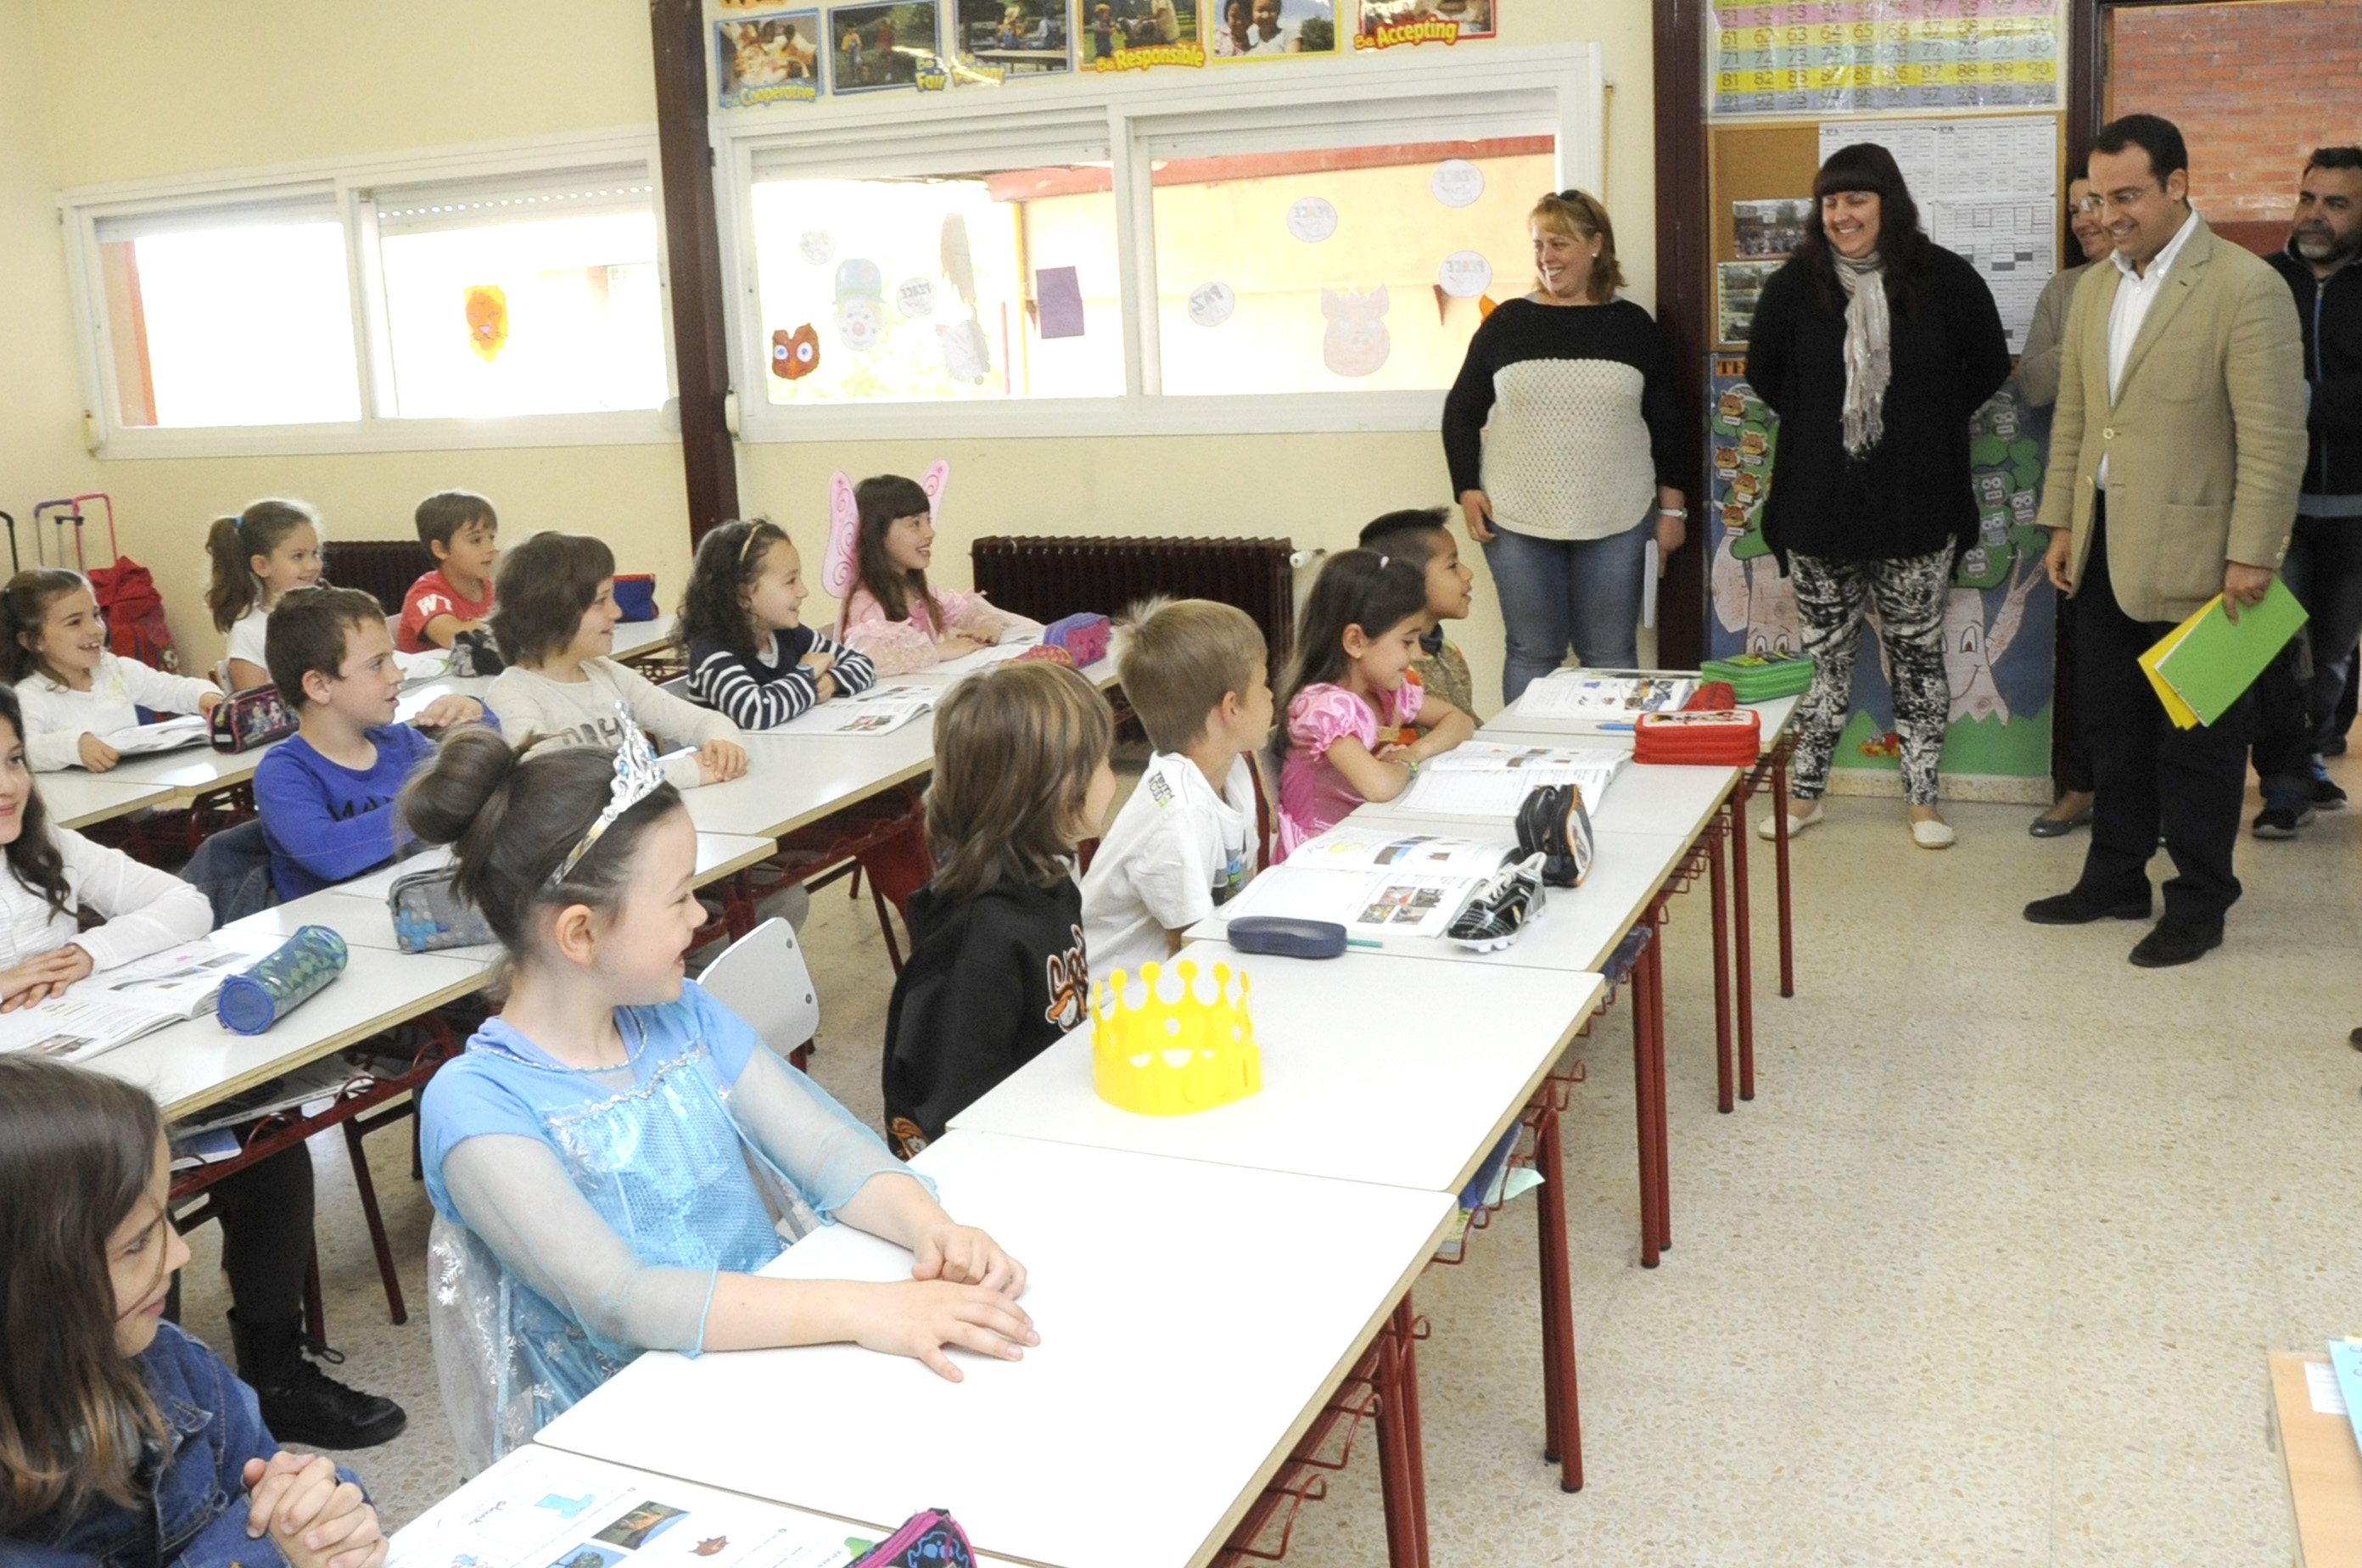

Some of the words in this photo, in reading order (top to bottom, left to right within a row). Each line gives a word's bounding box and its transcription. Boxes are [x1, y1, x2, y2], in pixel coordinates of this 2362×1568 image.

[1722, 9, 1738, 22] 51
[1755, 6, 1772, 20] 52
[1788, 4, 1807, 19] 53
[1354, 35, 1374, 49] Be
[1376, 17, 1458, 48] Accepting
[1721, 31, 1738, 45] 61
[1754, 28, 1774, 43] 62
[1787, 26, 1807, 41] 63
[1821, 25, 1841, 39] 64
[1854, 23, 1873, 38] 65
[1887, 23, 1910, 36] 66
[1922, 21, 1941, 36] 67
[1957, 20, 1979, 34] 68
[1993, 18, 2013, 33] 69
[2029, 17, 2051, 32] 70
[1113, 42, 1204, 70] Responsible
[1721, 52, 1739, 64] 71
[1755, 50, 1772, 64] 72
[1788, 48, 1808, 62] 73
[1855, 46, 1873, 59] 75
[1923, 42, 1942, 57] 77
[1995, 40, 2014, 53] 79
[915, 71, 946, 91] Fair
[1722, 73, 1738, 87] 81
[1754, 71, 1774, 85] 82
[1788, 70, 1808, 83] 83
[1854, 67, 1872, 80] 85
[1887, 65, 1908, 80] 86
[1922, 64, 1941, 78] 87
[1956, 63, 1978, 76] 88
[1993, 62, 2013, 76] 89
[2027, 62, 2050, 75] 90
[741, 86, 815, 106] Cooperative
[1721, 95, 1739, 107] 91
[1755, 93, 1774, 106] 92
[1922, 87, 1940, 100] 97
[1956, 86, 1977, 98] 98
